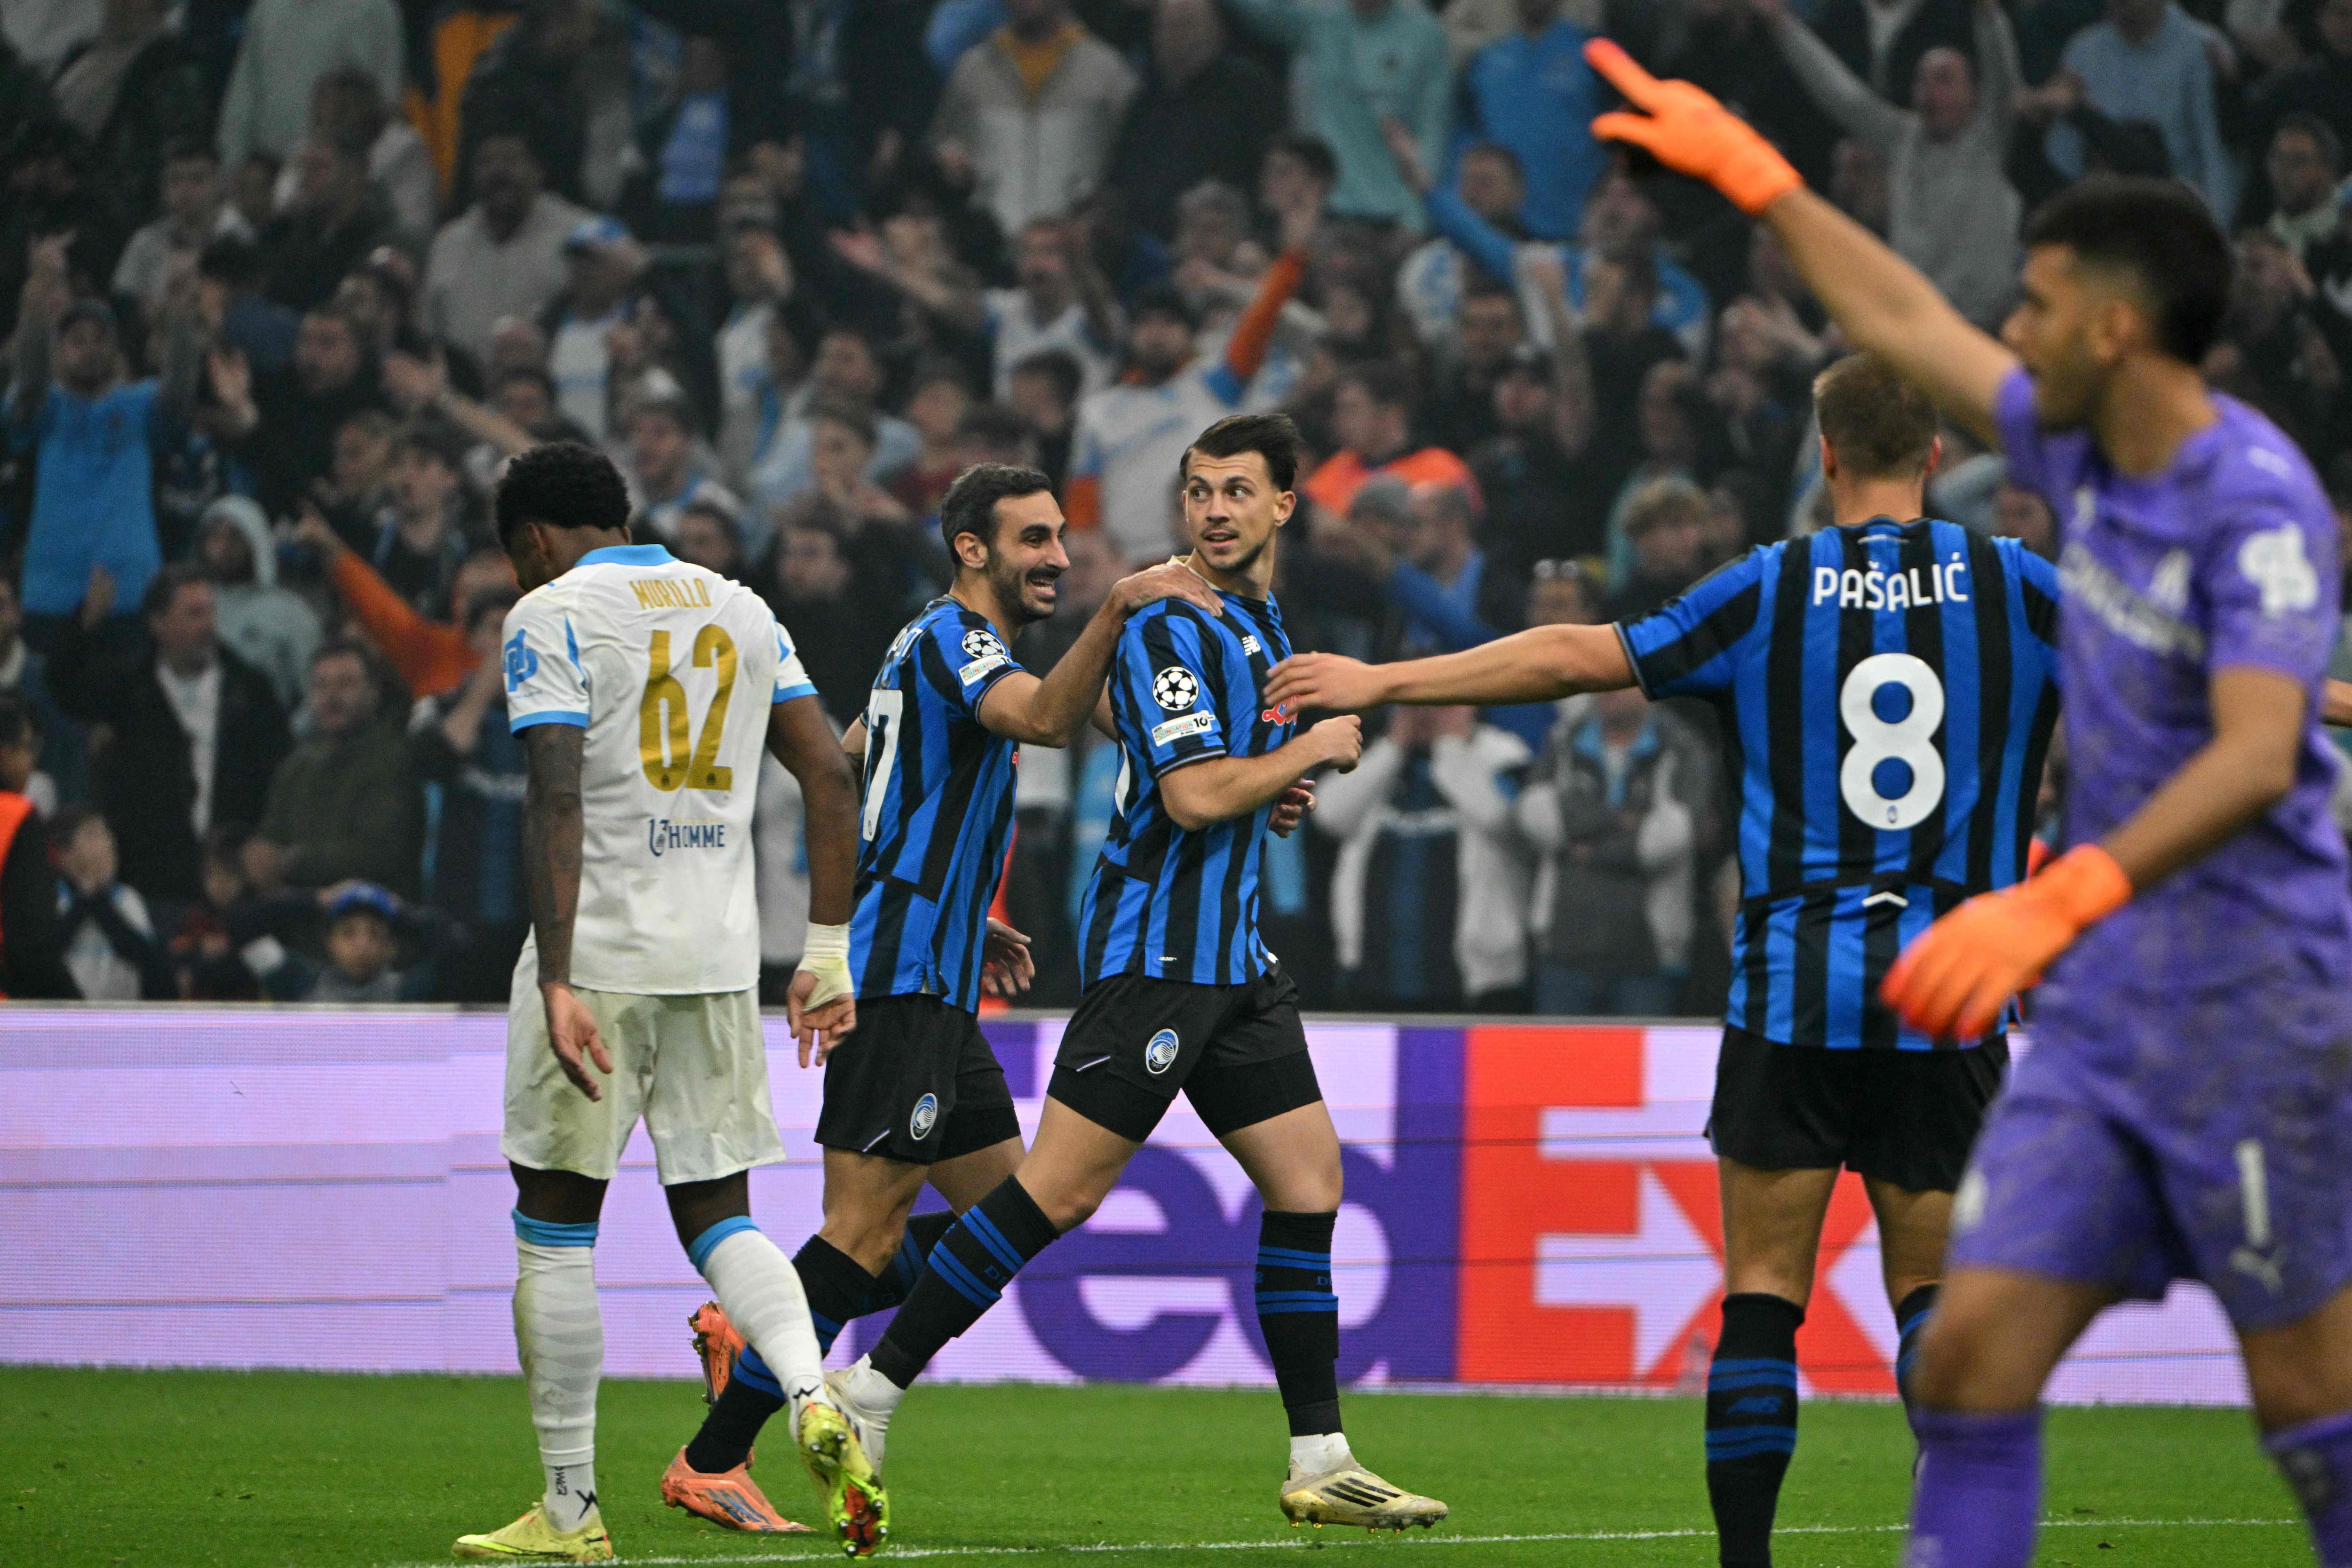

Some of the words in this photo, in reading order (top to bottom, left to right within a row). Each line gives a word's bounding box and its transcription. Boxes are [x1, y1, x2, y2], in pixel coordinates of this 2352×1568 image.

[629, 578, 711, 610] MURILLO
[1813, 552, 1969, 613] PAŠALIĆ
[639, 623, 738, 792] 62
[1154, 721, 1193, 740] FOUNDATION
[1193, 716, 1208, 728] 10
[1840, 652, 1946, 832] 8
[2234, 1137, 2272, 1248] 1
